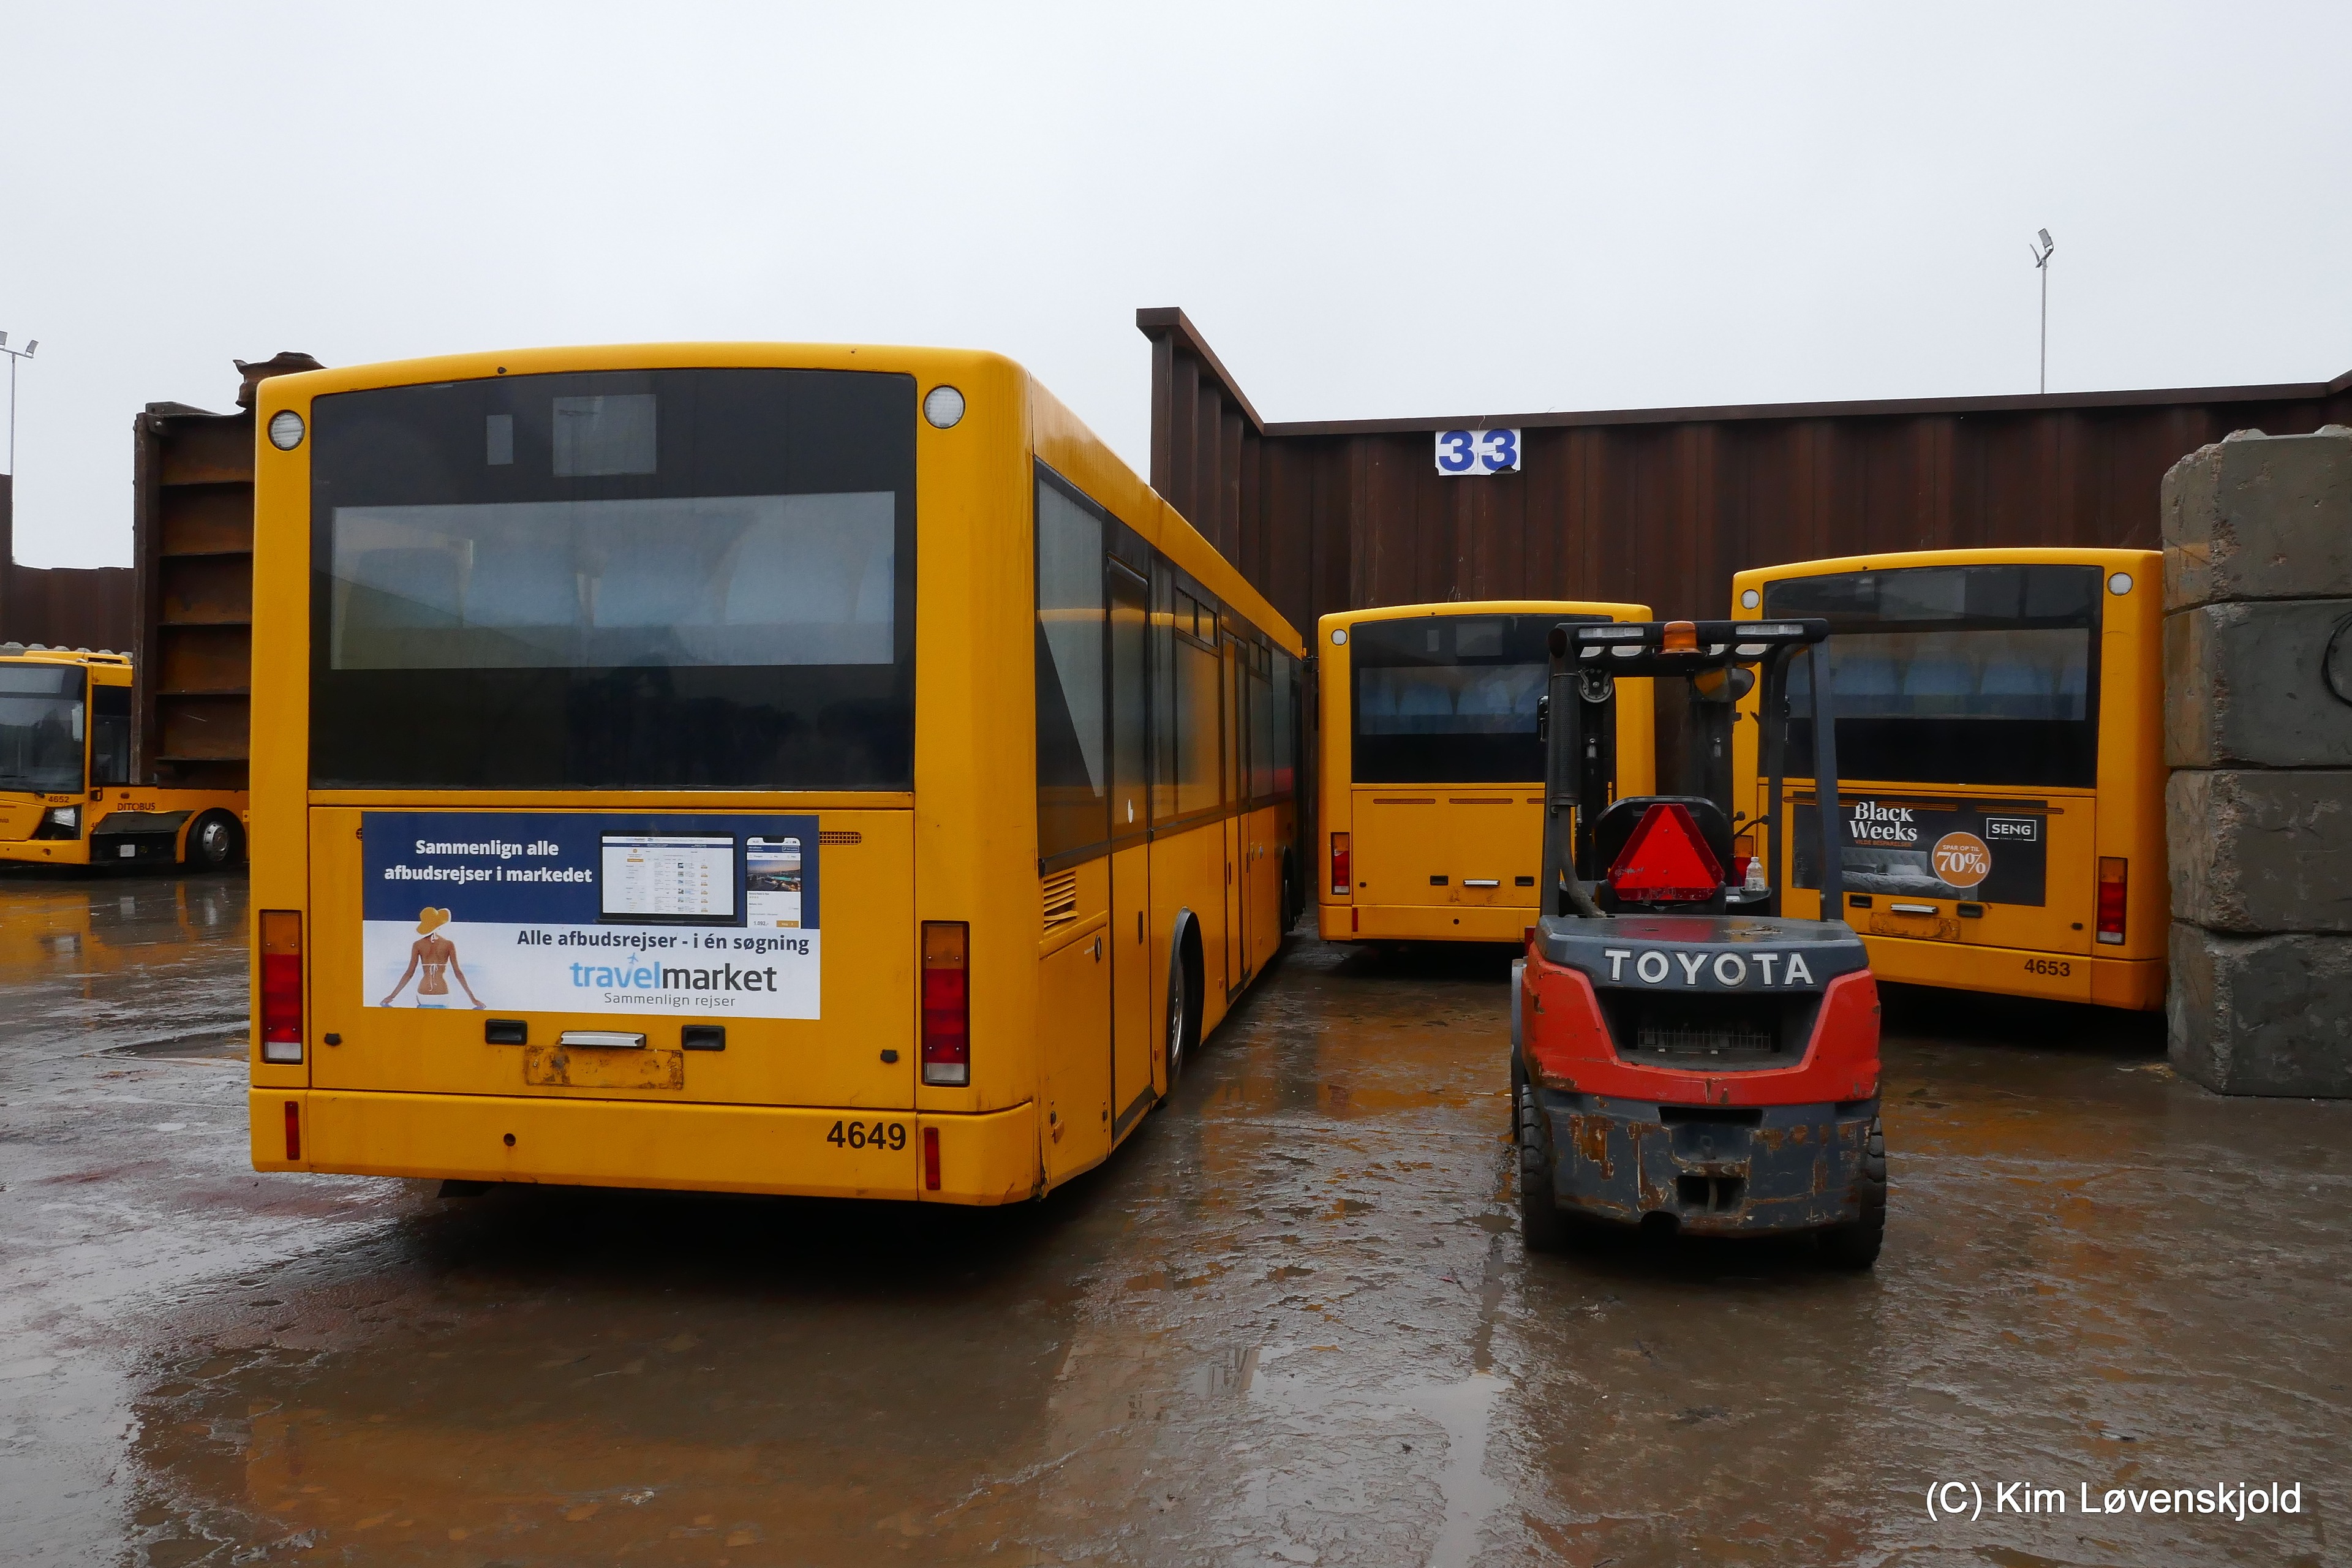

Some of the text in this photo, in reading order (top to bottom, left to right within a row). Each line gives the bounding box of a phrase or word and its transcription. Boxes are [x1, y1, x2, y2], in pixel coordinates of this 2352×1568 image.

[1439, 429, 1517, 472] 33
[117, 802, 156, 811] DITOBUS
[1854, 801, 1913, 822] Black
[1849, 820, 1918, 842] Weeks
[1991, 824, 2031, 835] SENG
[415, 840, 559, 859] Sammenlign alle
[1937, 852, 1986, 874] 70%
[384, 865, 593, 884] afbudsrejser i markedet
[518, 930, 552, 946] Alle
[558, 931, 677, 951] afbudsrejser
[694, 933, 698, 949] i
[704, 933, 728, 949] én
[734, 935, 809, 955] søgning
[570, 961, 777, 992] travelmarket
[1605, 949, 1814, 986] TOYOTA
[2024, 959, 2071, 977] 4653
[605, 993, 735, 1008] Sammenlign rejser
[826, 1120, 906, 1150] 4649
